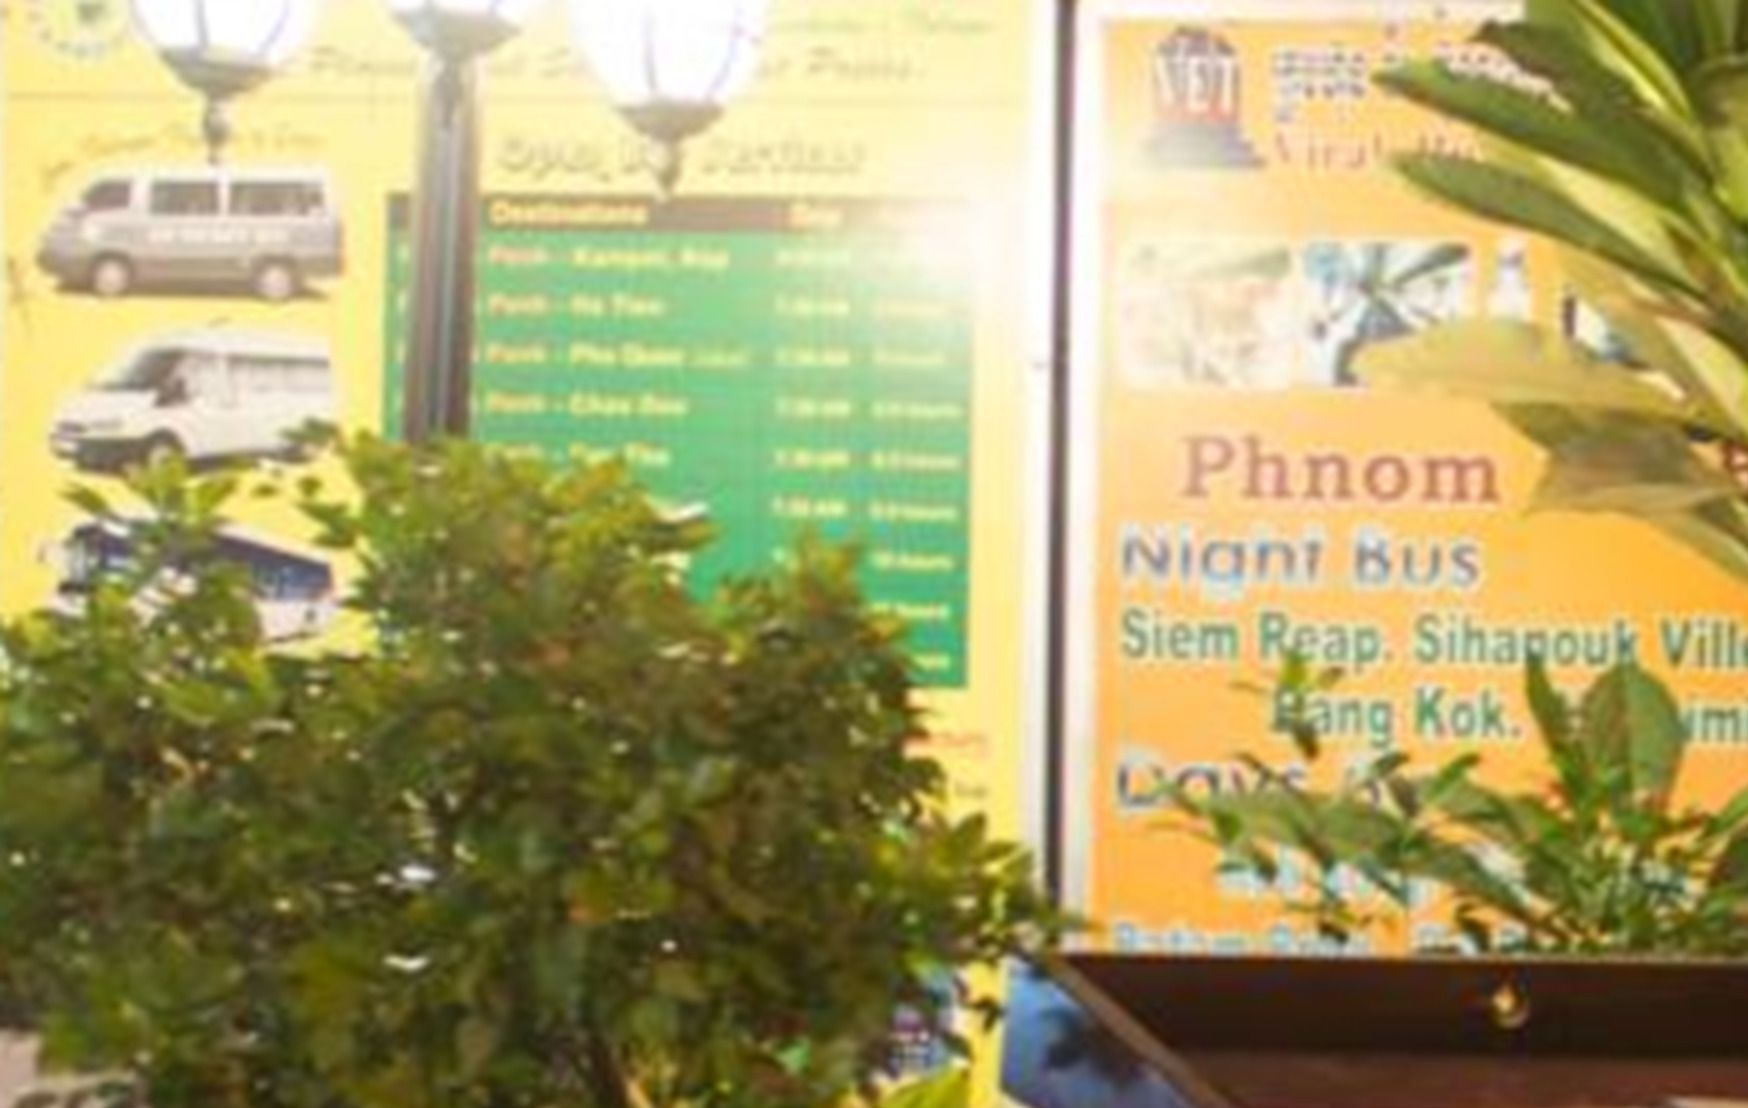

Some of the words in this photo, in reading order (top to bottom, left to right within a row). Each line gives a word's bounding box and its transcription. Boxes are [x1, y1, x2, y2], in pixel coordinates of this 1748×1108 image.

[1178, 432, 1502, 503] Phnom
[1352, 528, 1480, 586] Bus
[1118, 605, 1241, 663] Siem
